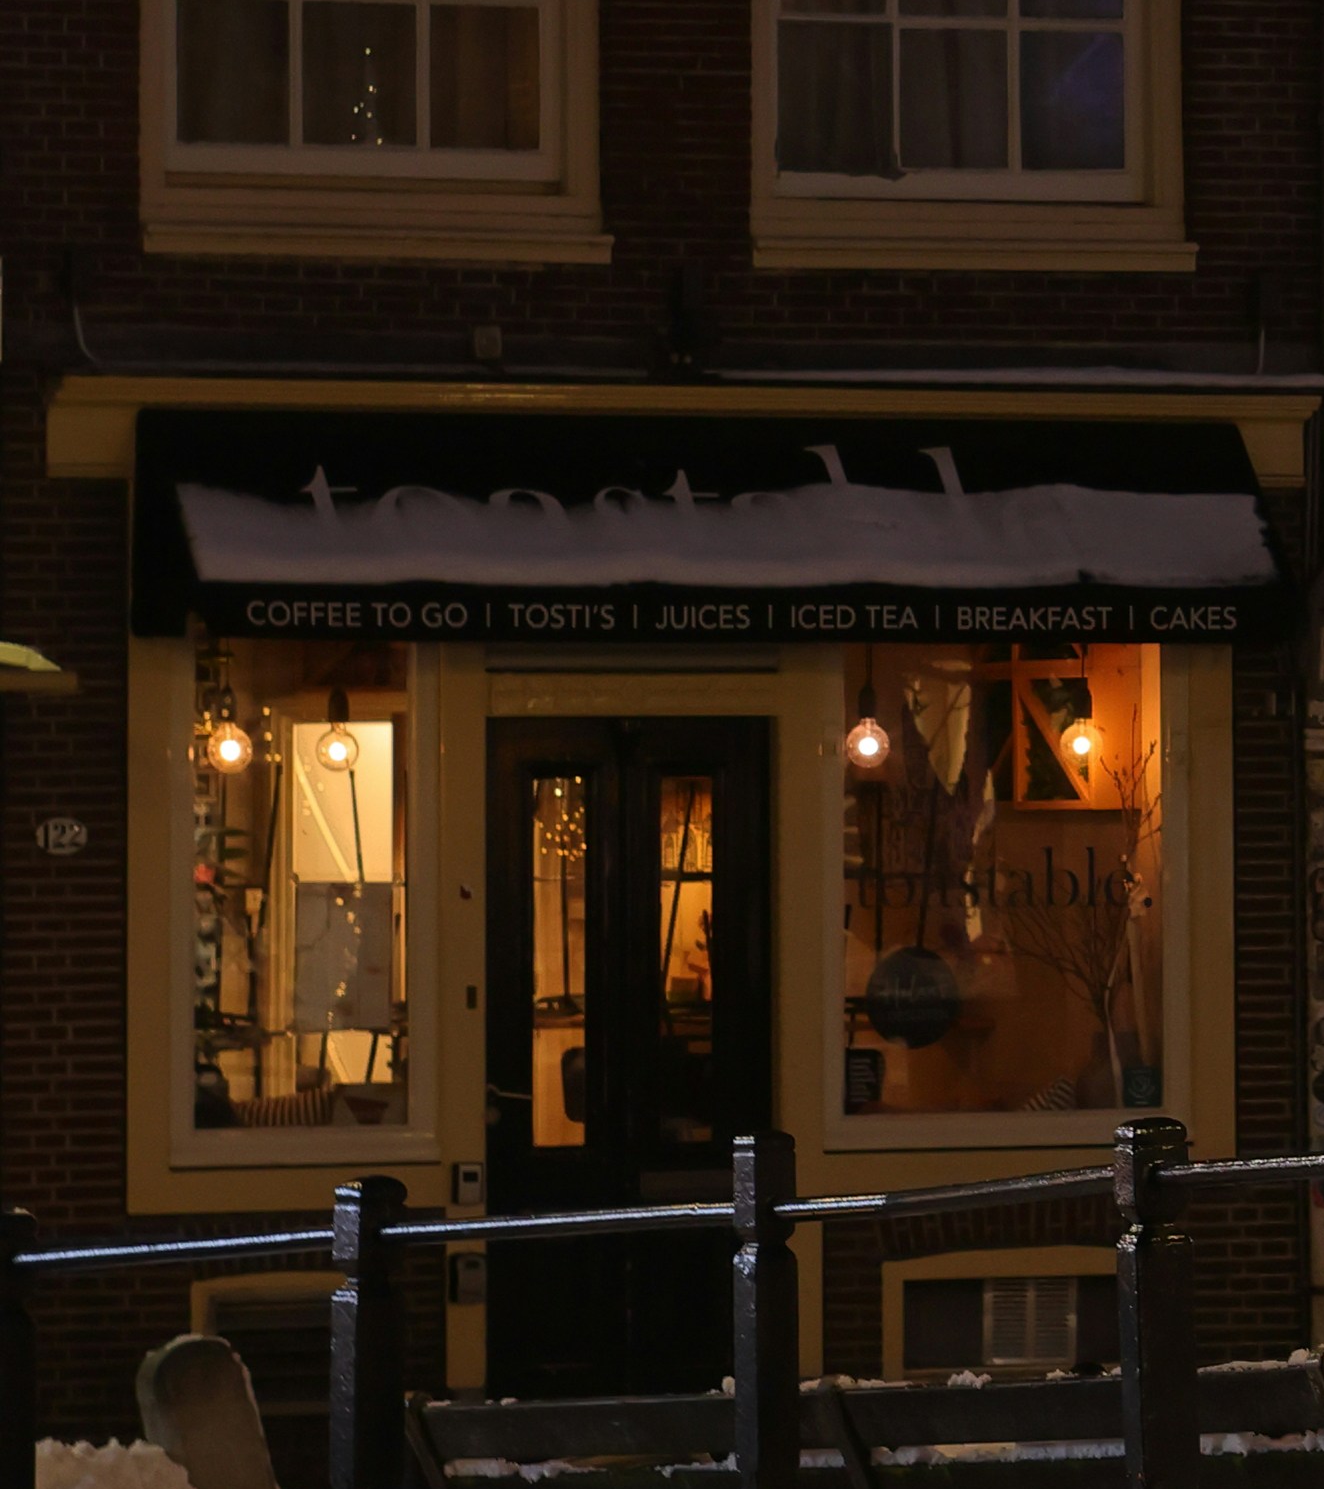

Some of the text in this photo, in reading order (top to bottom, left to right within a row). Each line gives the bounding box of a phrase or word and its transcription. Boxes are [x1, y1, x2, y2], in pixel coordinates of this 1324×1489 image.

[246, 600, 1238, 631] COFFEE TO GO TOSTI'S JUICES ICED TEA BREAKFAST CAKES
